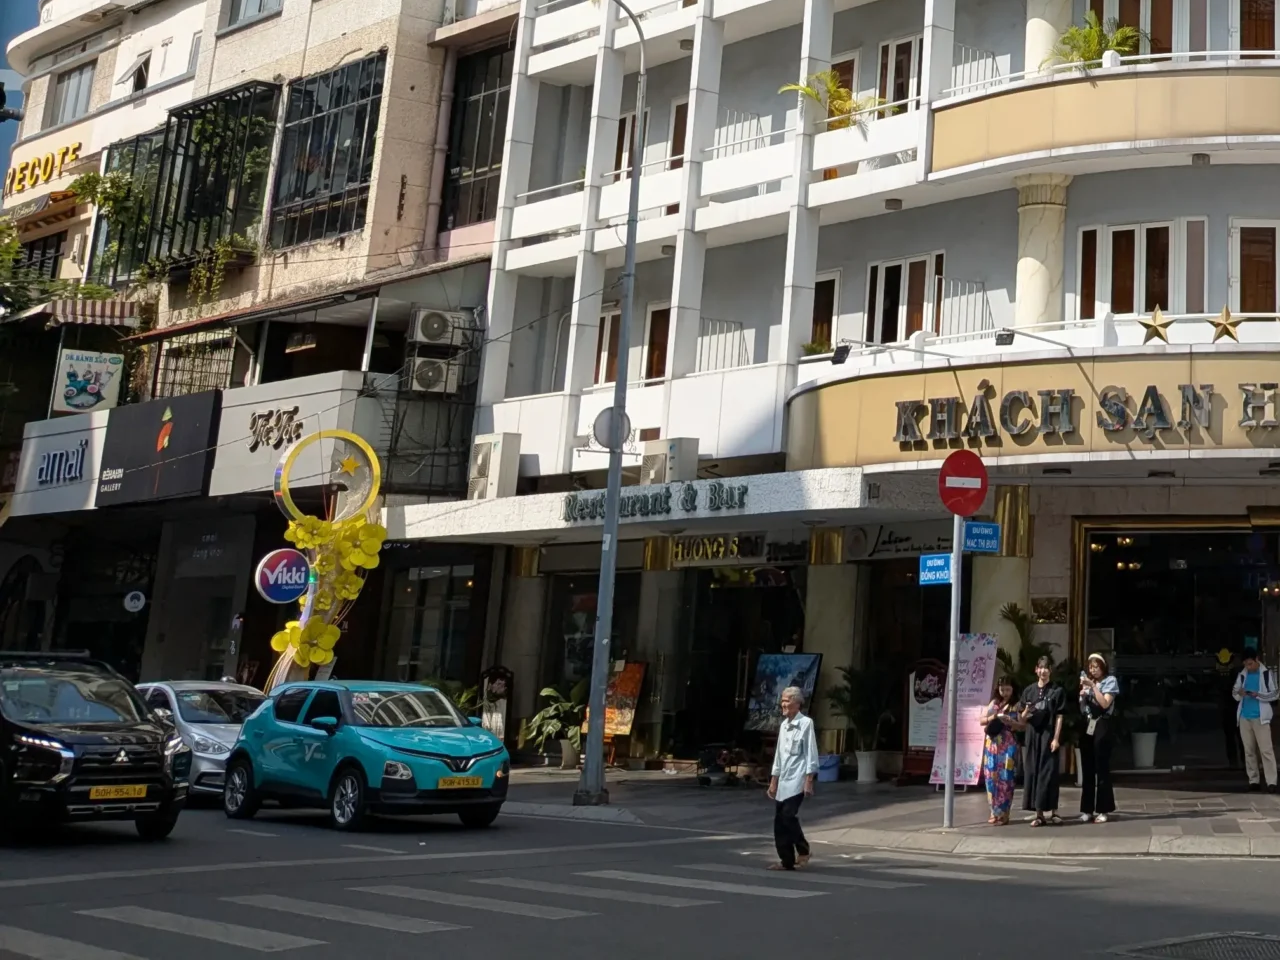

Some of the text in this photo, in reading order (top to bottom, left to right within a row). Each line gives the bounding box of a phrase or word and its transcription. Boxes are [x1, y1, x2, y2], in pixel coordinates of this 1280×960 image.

[893, 378, 1075, 442] KHÁCH
[1097, 384, 1214, 438] SẠN
[100, 483, 122, 493] GALLERY
[559, 485, 673, 522] Resturant
[705, 482, 749, 513] Bar
[263, 559, 306, 585] Vikki
